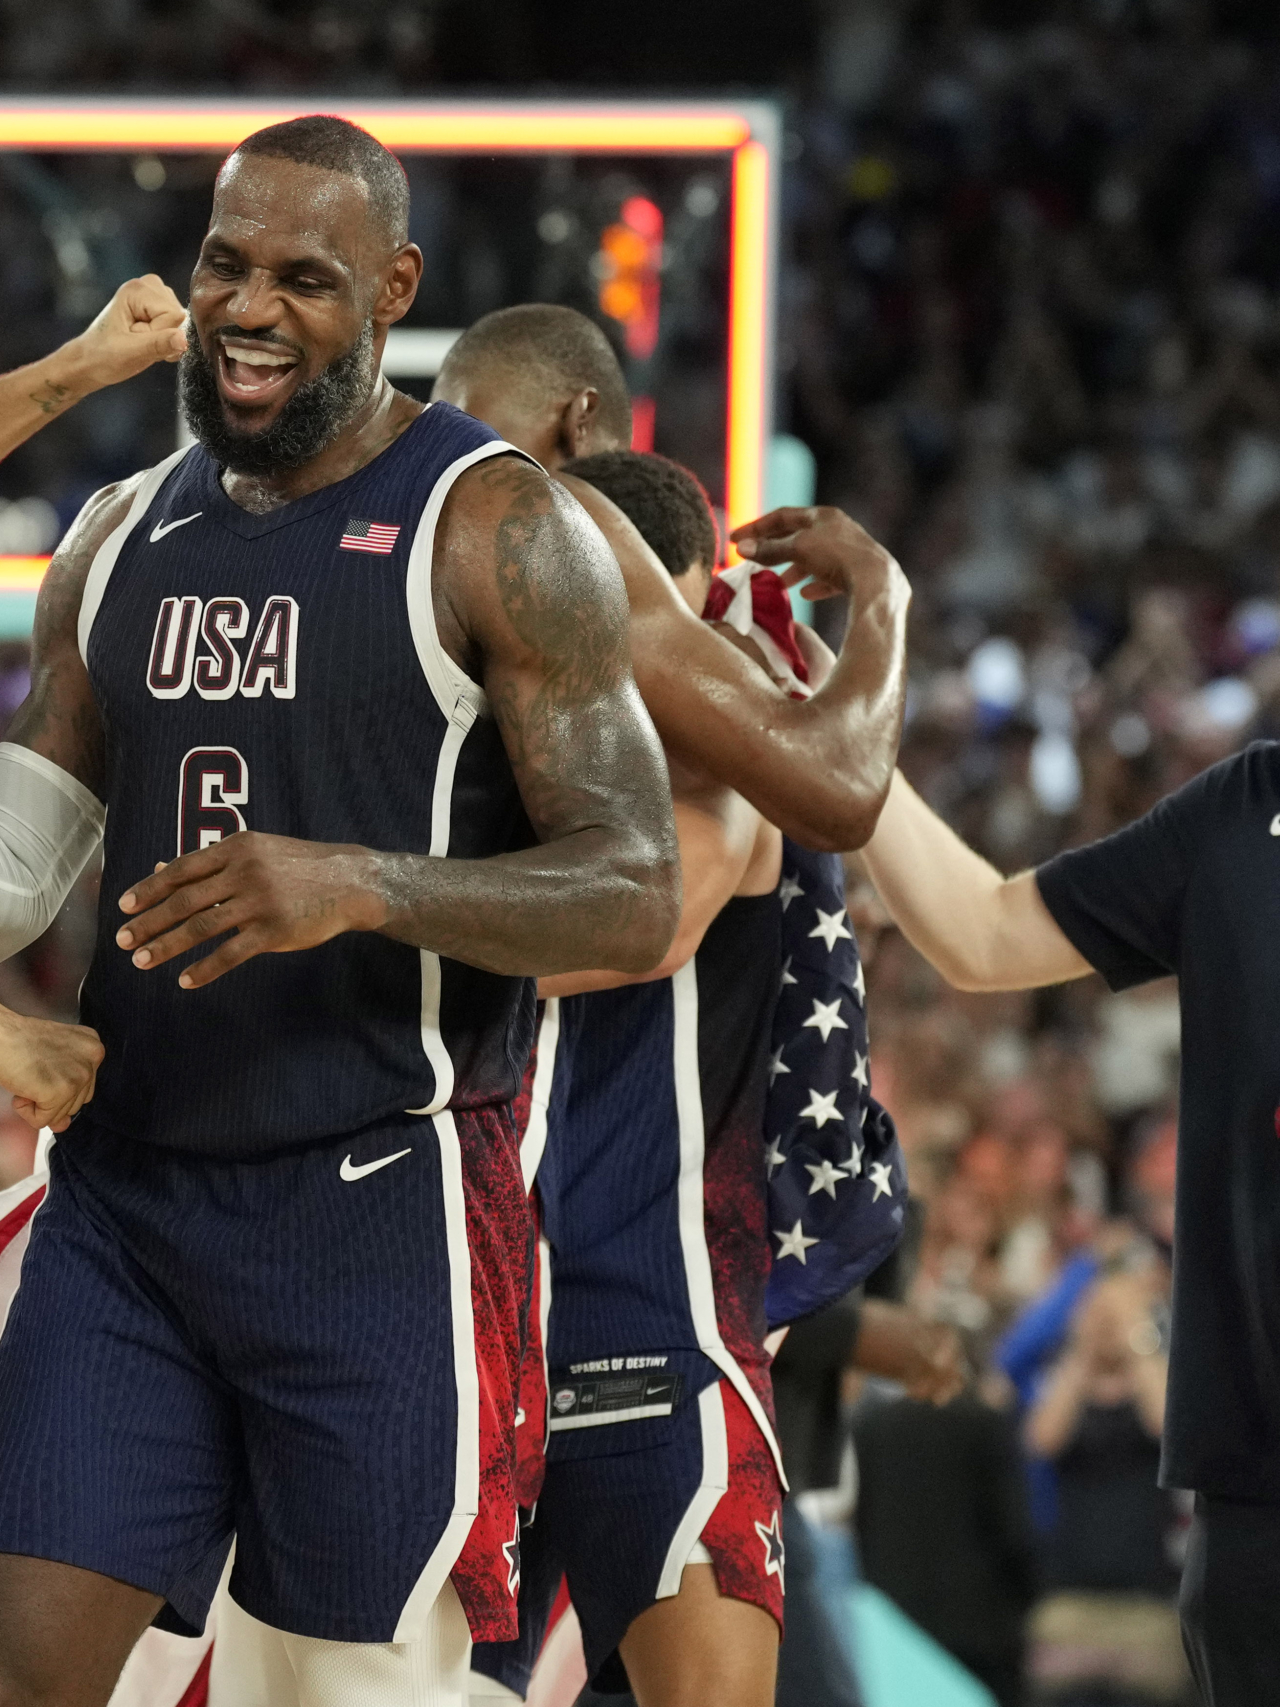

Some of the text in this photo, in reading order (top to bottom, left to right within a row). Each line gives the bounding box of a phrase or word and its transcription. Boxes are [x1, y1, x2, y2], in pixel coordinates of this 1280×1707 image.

[146, 595, 300, 700] USA
[177, 745, 249, 857] 6
[569, 1356, 668, 1374] SPARKS OF DESTINY
